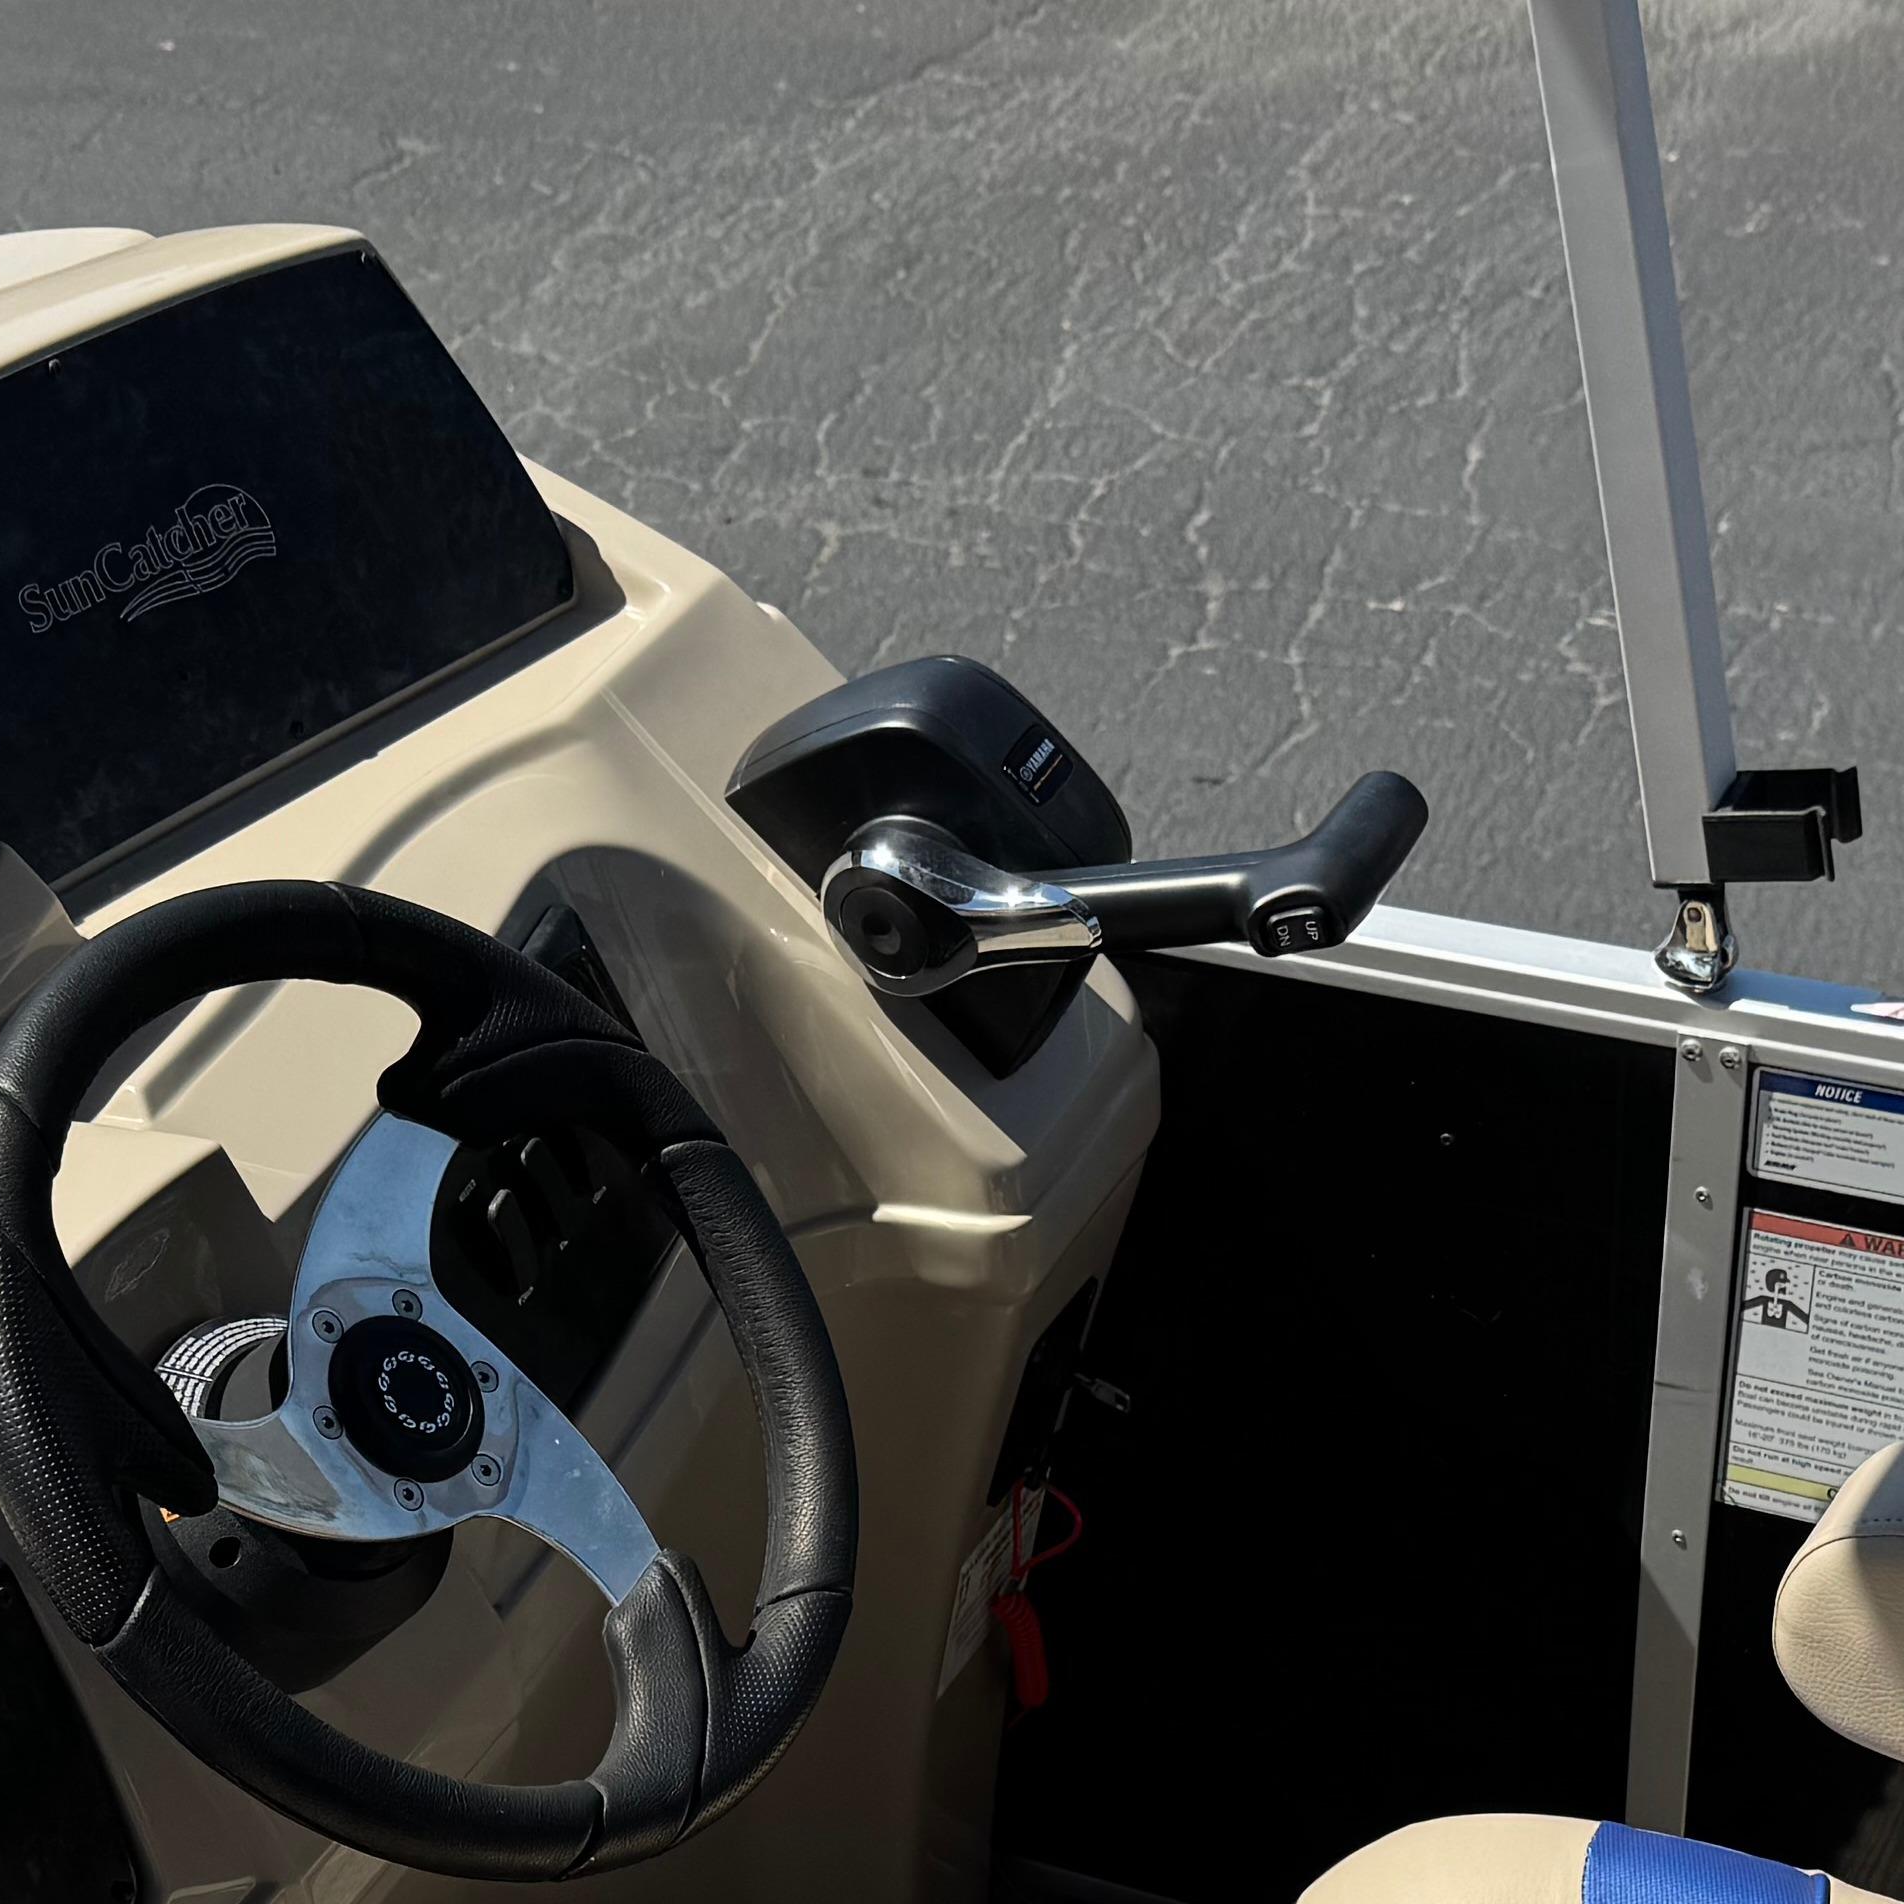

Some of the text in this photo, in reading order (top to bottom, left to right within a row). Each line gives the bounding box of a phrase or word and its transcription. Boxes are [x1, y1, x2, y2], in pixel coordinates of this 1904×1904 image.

[18, 492, 247, 633] SunCatcher
[1276, 924, 1291, 947] DN
[1304, 920, 1318, 940] UP
[1814, 1084, 1862, 1103] NOTICE
